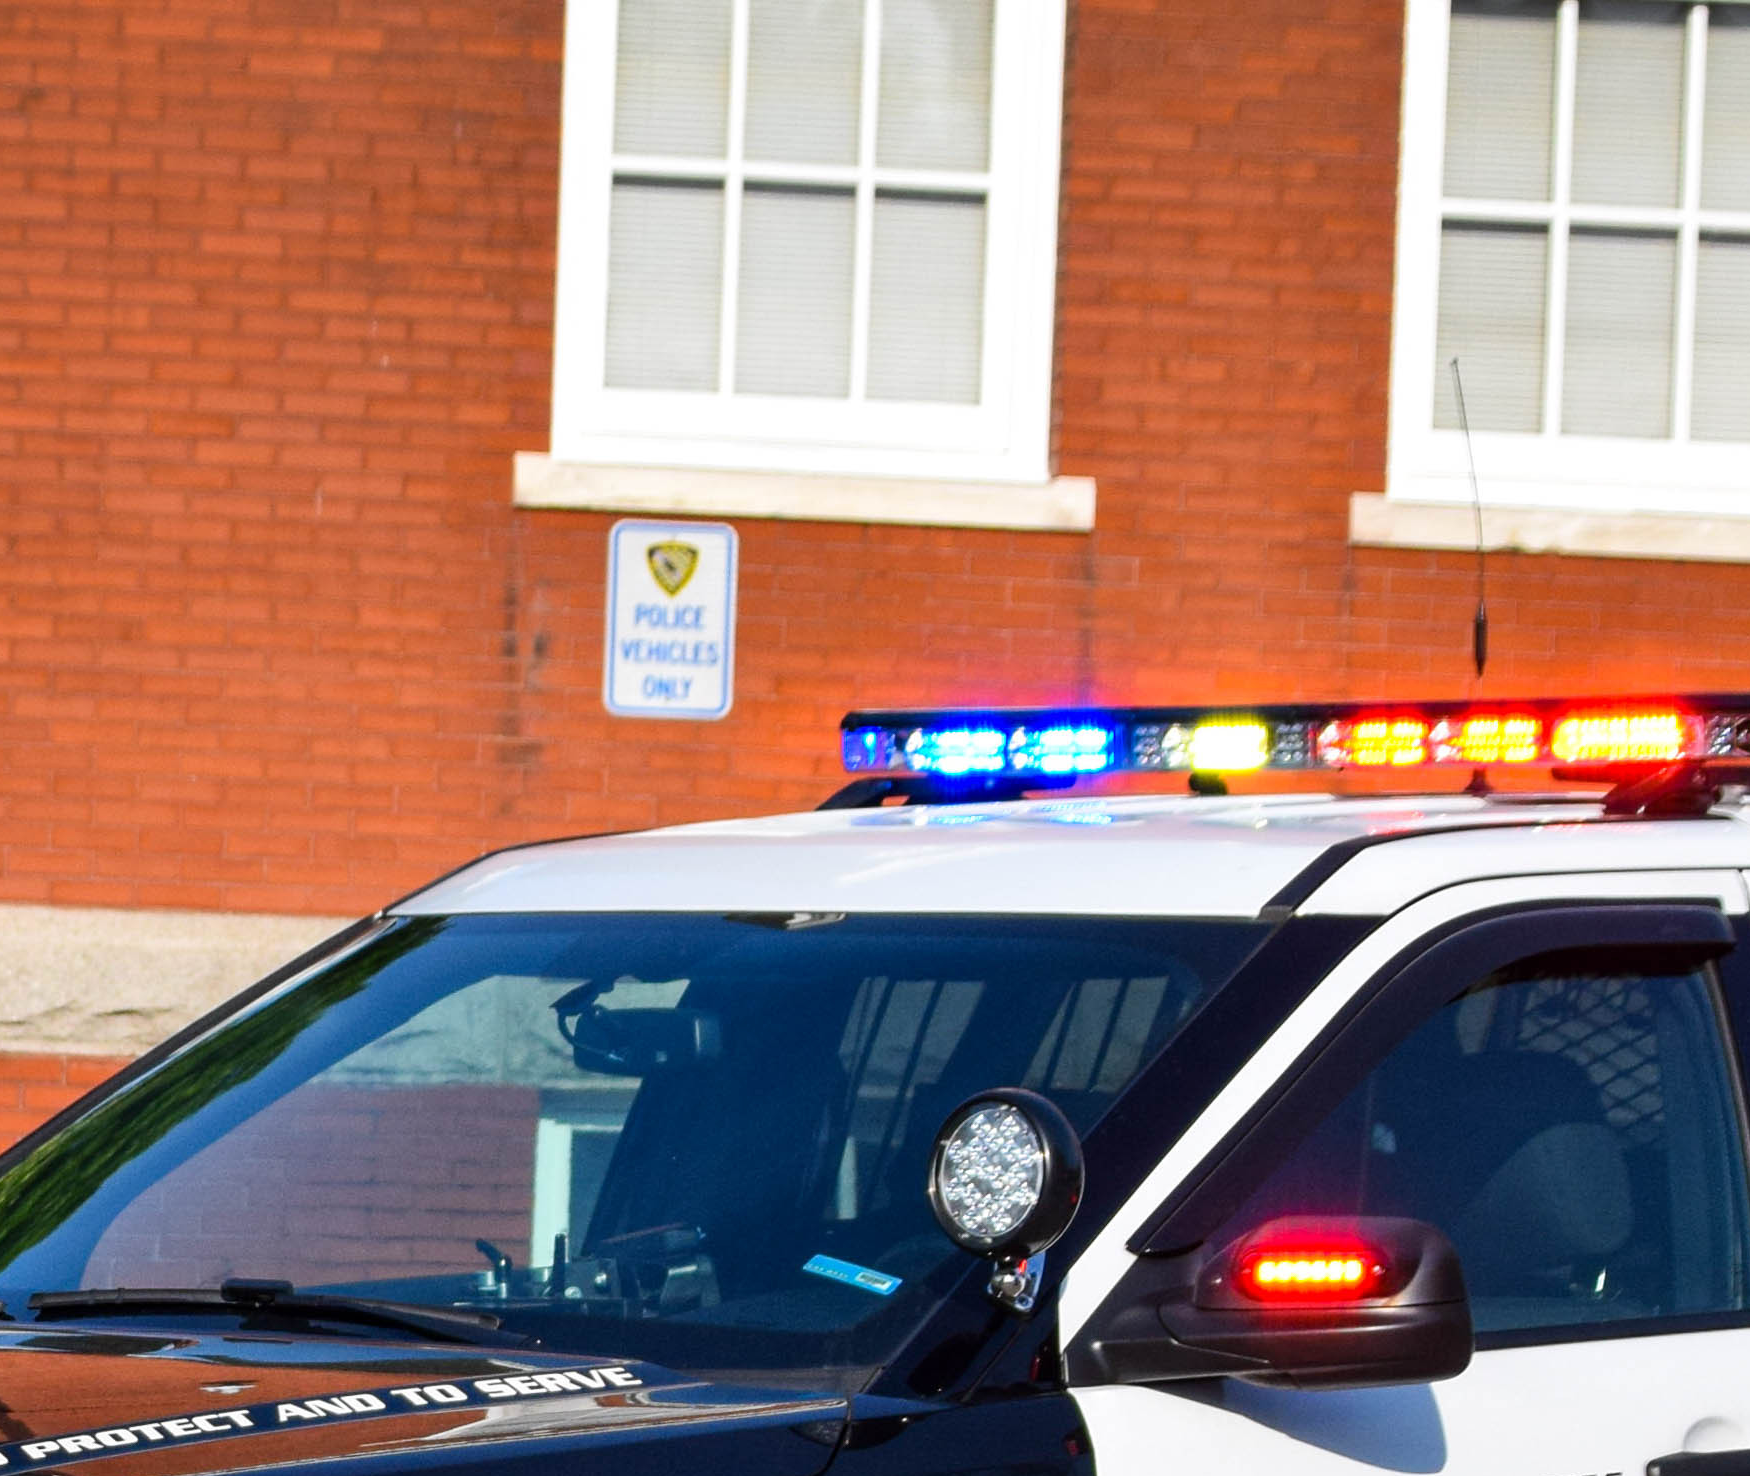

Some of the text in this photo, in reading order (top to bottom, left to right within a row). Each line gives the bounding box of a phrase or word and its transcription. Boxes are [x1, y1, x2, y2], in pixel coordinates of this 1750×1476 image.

[634, 603, 705, 630] POLICE
[621, 639, 720, 667] VEHICLES
[642, 675, 692, 699] ONLY
[20, 1409, 255, 1460] PROTECT
[277, 1393, 387, 1423] AND
[391, 1384, 468, 1406] TO
[474, 1367, 643, 1399] SERVE
